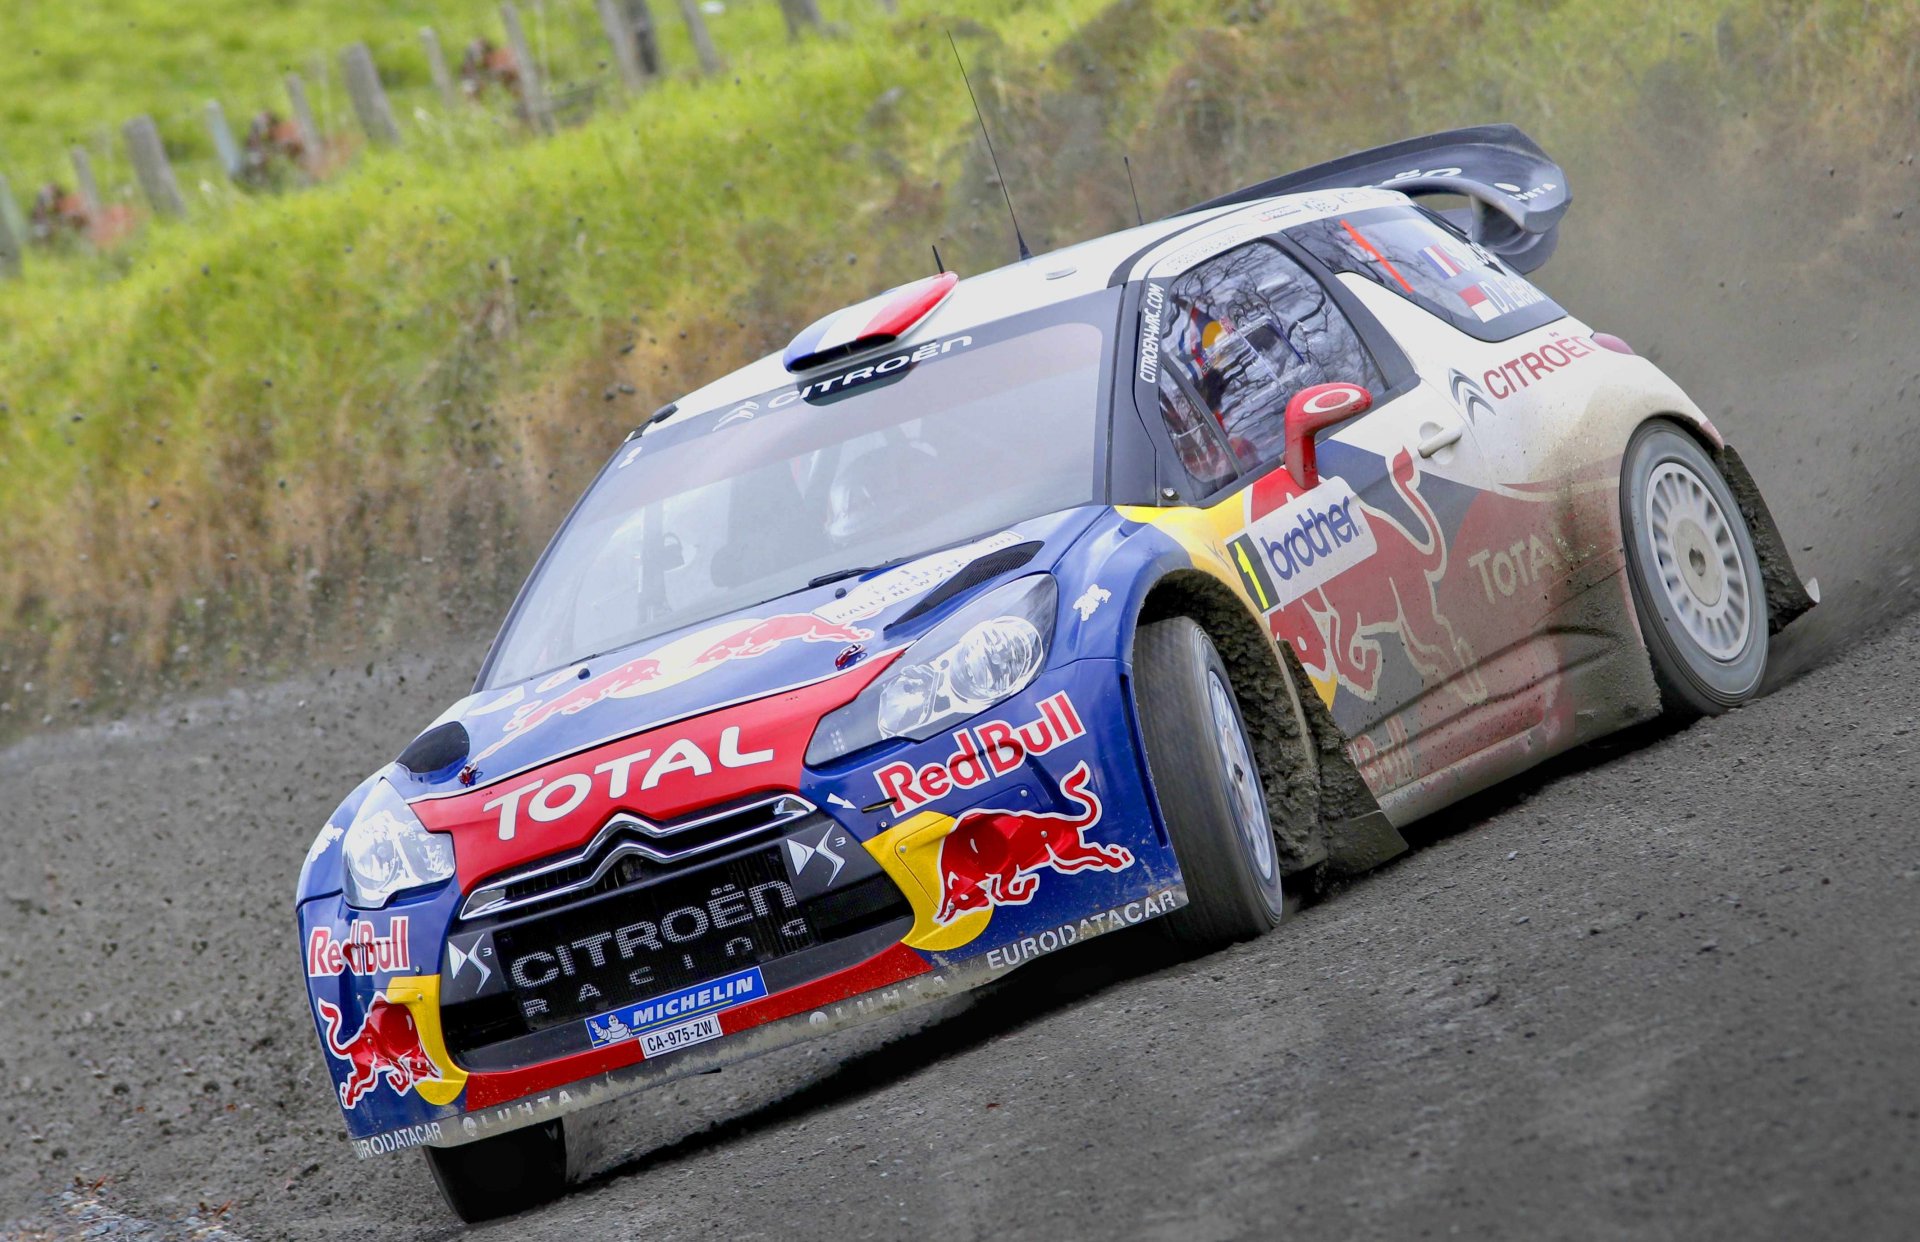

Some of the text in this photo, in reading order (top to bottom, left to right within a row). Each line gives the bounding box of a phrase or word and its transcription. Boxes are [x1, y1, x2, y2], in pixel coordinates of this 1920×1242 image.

[1140, 283, 1165, 384] CITROEN-WRC.COM
[1234, 495, 1360, 609] 1 brother
[482, 726, 774, 841] TOTAL
[874, 690, 1086, 818] Red Bull
[986, 889, 1176, 970] EURODATACAR
[633, 975, 753, 1027] MICHELIN
[646, 1020, 713, 1052] CA-975-ZW
